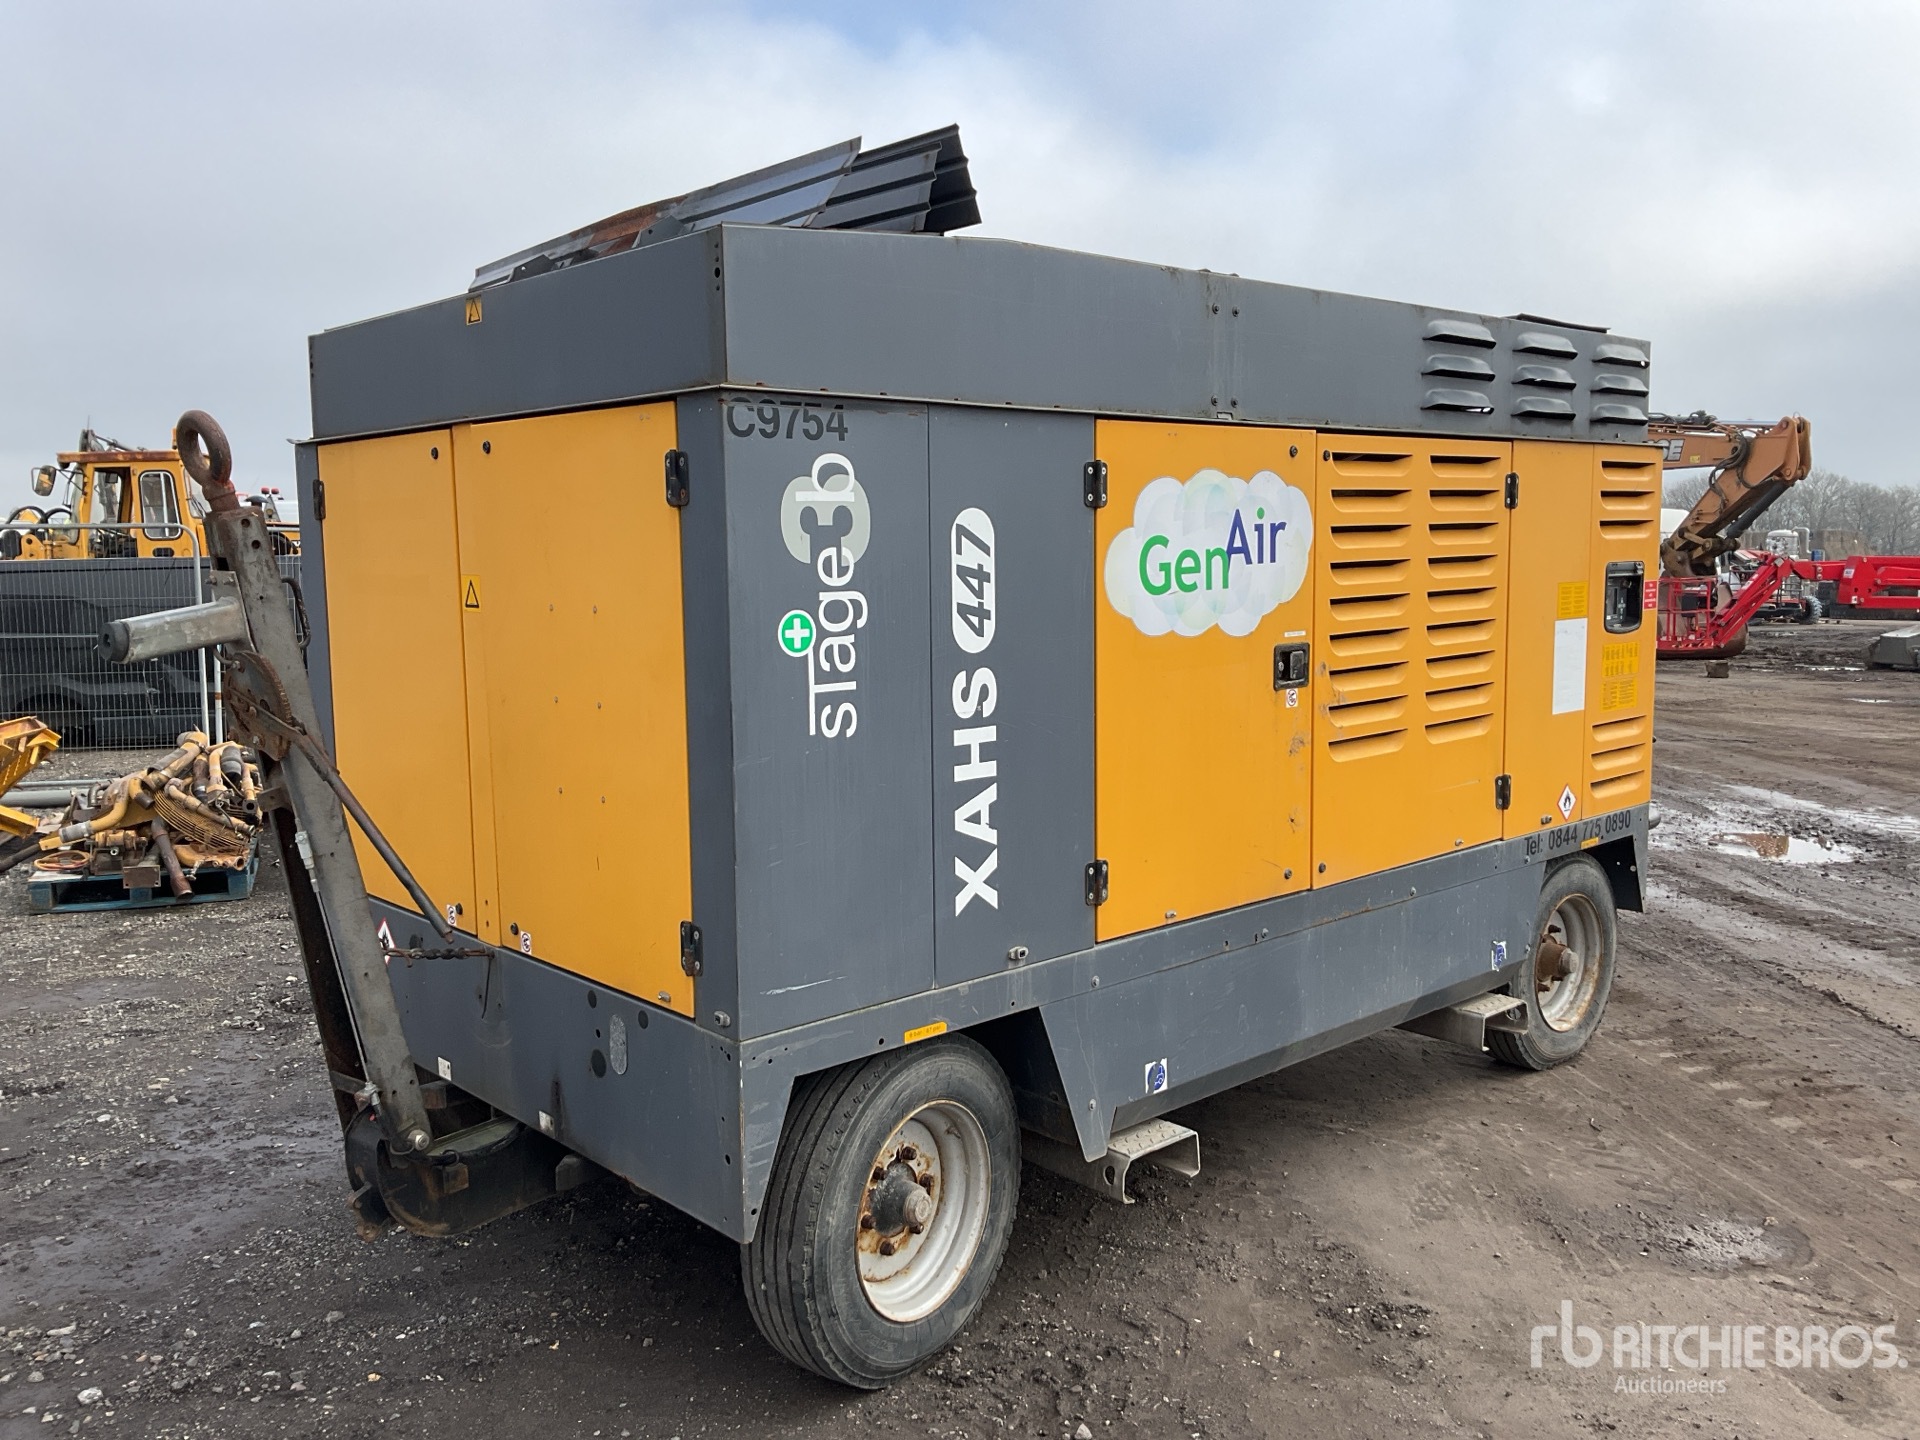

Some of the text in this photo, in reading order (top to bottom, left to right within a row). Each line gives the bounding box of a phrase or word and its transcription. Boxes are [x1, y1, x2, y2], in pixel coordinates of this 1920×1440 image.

[727, 397, 848, 441] C9754
[953, 523, 999, 917] XAHS 447
[1524, 810, 1631, 856] Tel: 0844 775 0890
